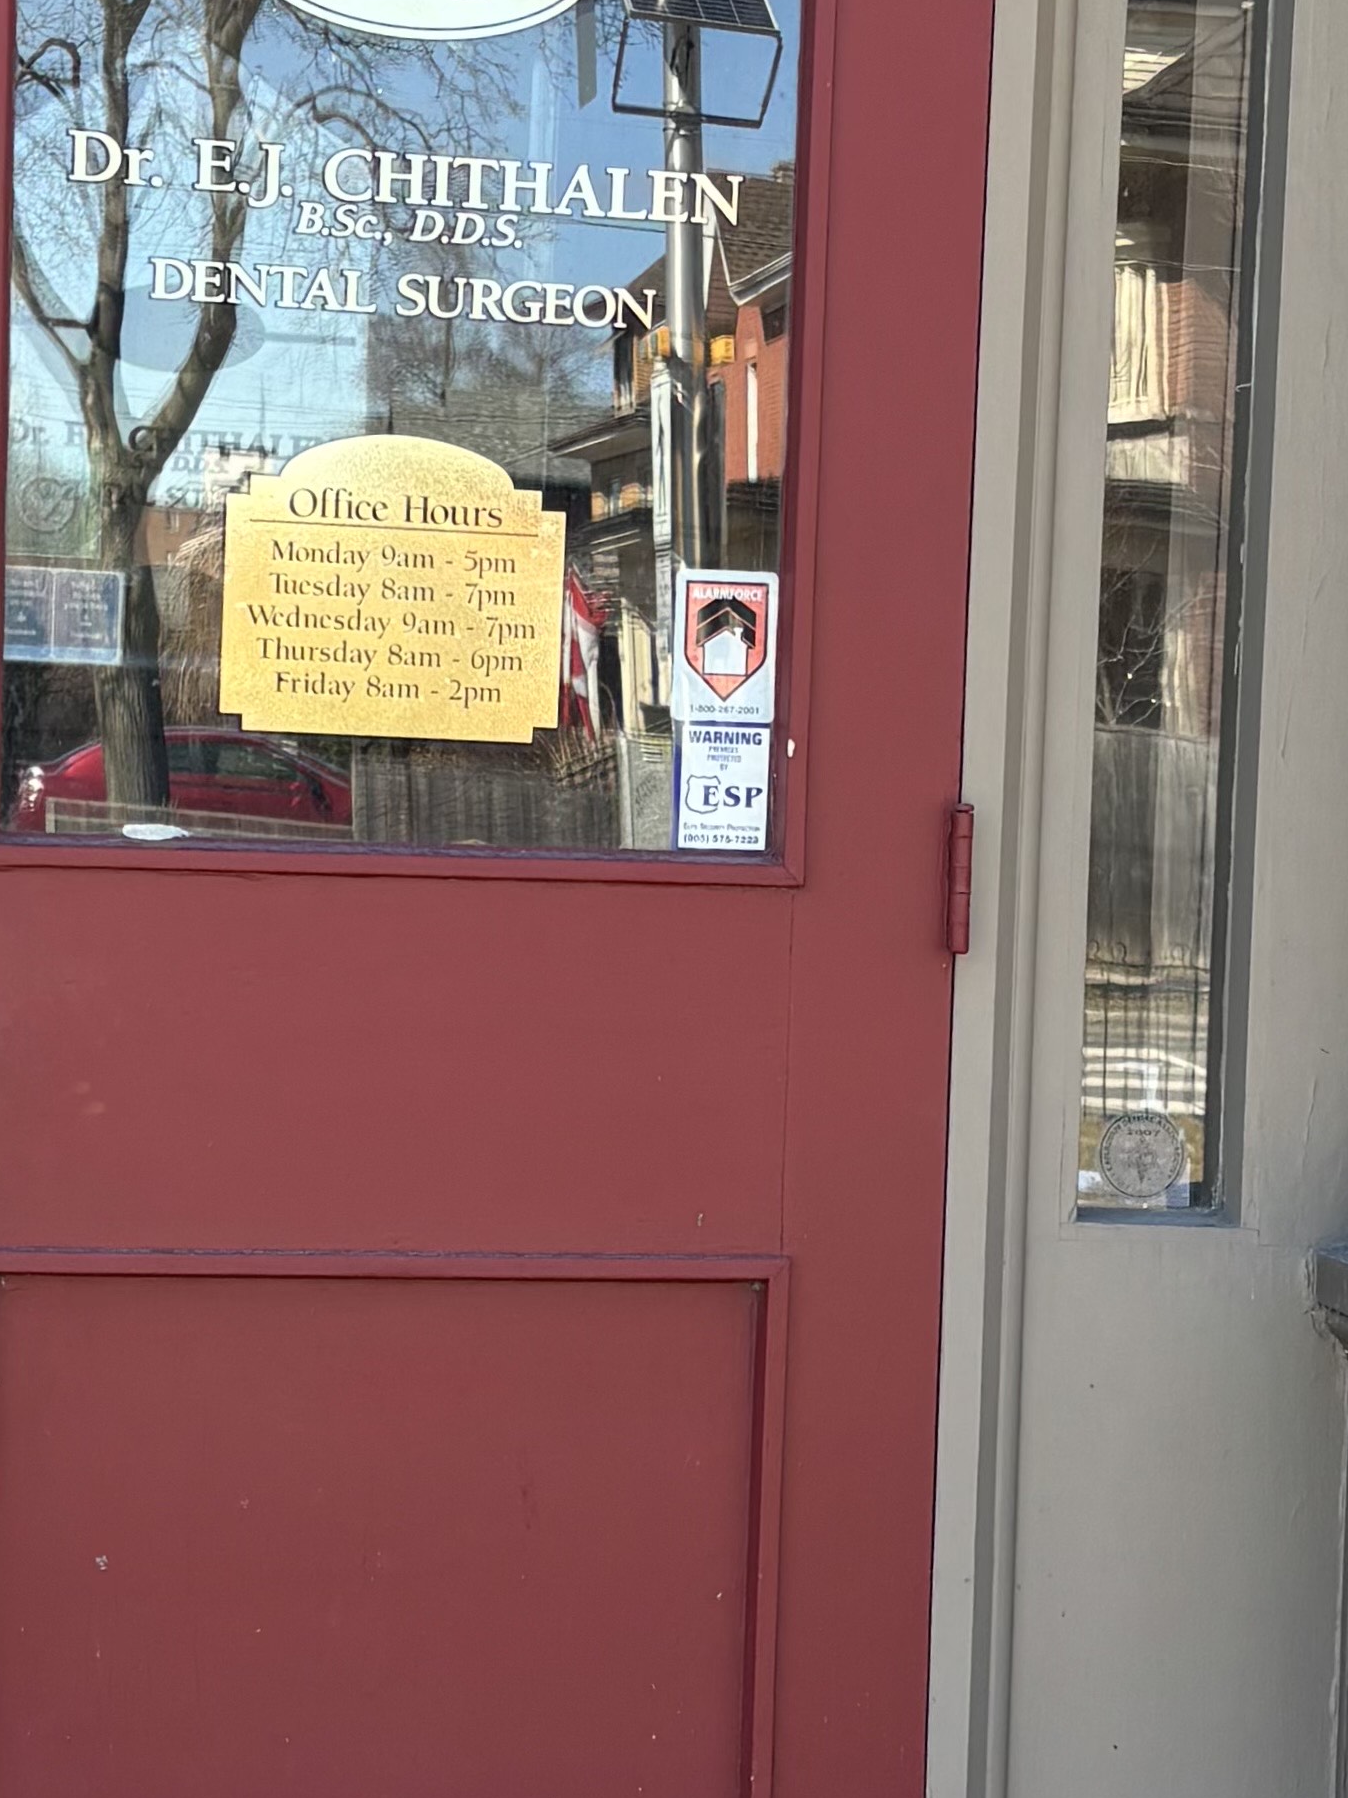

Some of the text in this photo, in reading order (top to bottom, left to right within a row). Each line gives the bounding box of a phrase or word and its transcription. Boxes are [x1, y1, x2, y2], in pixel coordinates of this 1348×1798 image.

[67, 129, 744, 227] Dr. E.J. CHITHALEN
[410, 212, 524, 250] D.D.S.
[150, 255, 658, 330] DENTAL SURGEON
[289, 487, 503, 529] Office Hours
[271, 539, 371, 572] Monday
[381, 544, 435, 569] 9am
[463, 550, 516, 579] 5pm
[269, 573, 371, 605] Tuesday
[381, 577, 435, 602] 8am
[465, 583, 516, 612] 7pm
[247, 605, 391, 639] Wednesday
[402, 612, 455, 636] 9am
[486, 617, 536, 645] 7pm
[256, 637, 377, 671] Thursday
[387, 643, 441, 668] 8am
[471, 648, 523, 677] 6pm
[275, 671, 356, 703] Friday
[366, 675, 419, 699] 8am
[449, 679, 501, 709] 2pm
[689, 730, 762, 746] WARNING
[703, 785, 763, 808] ESP
